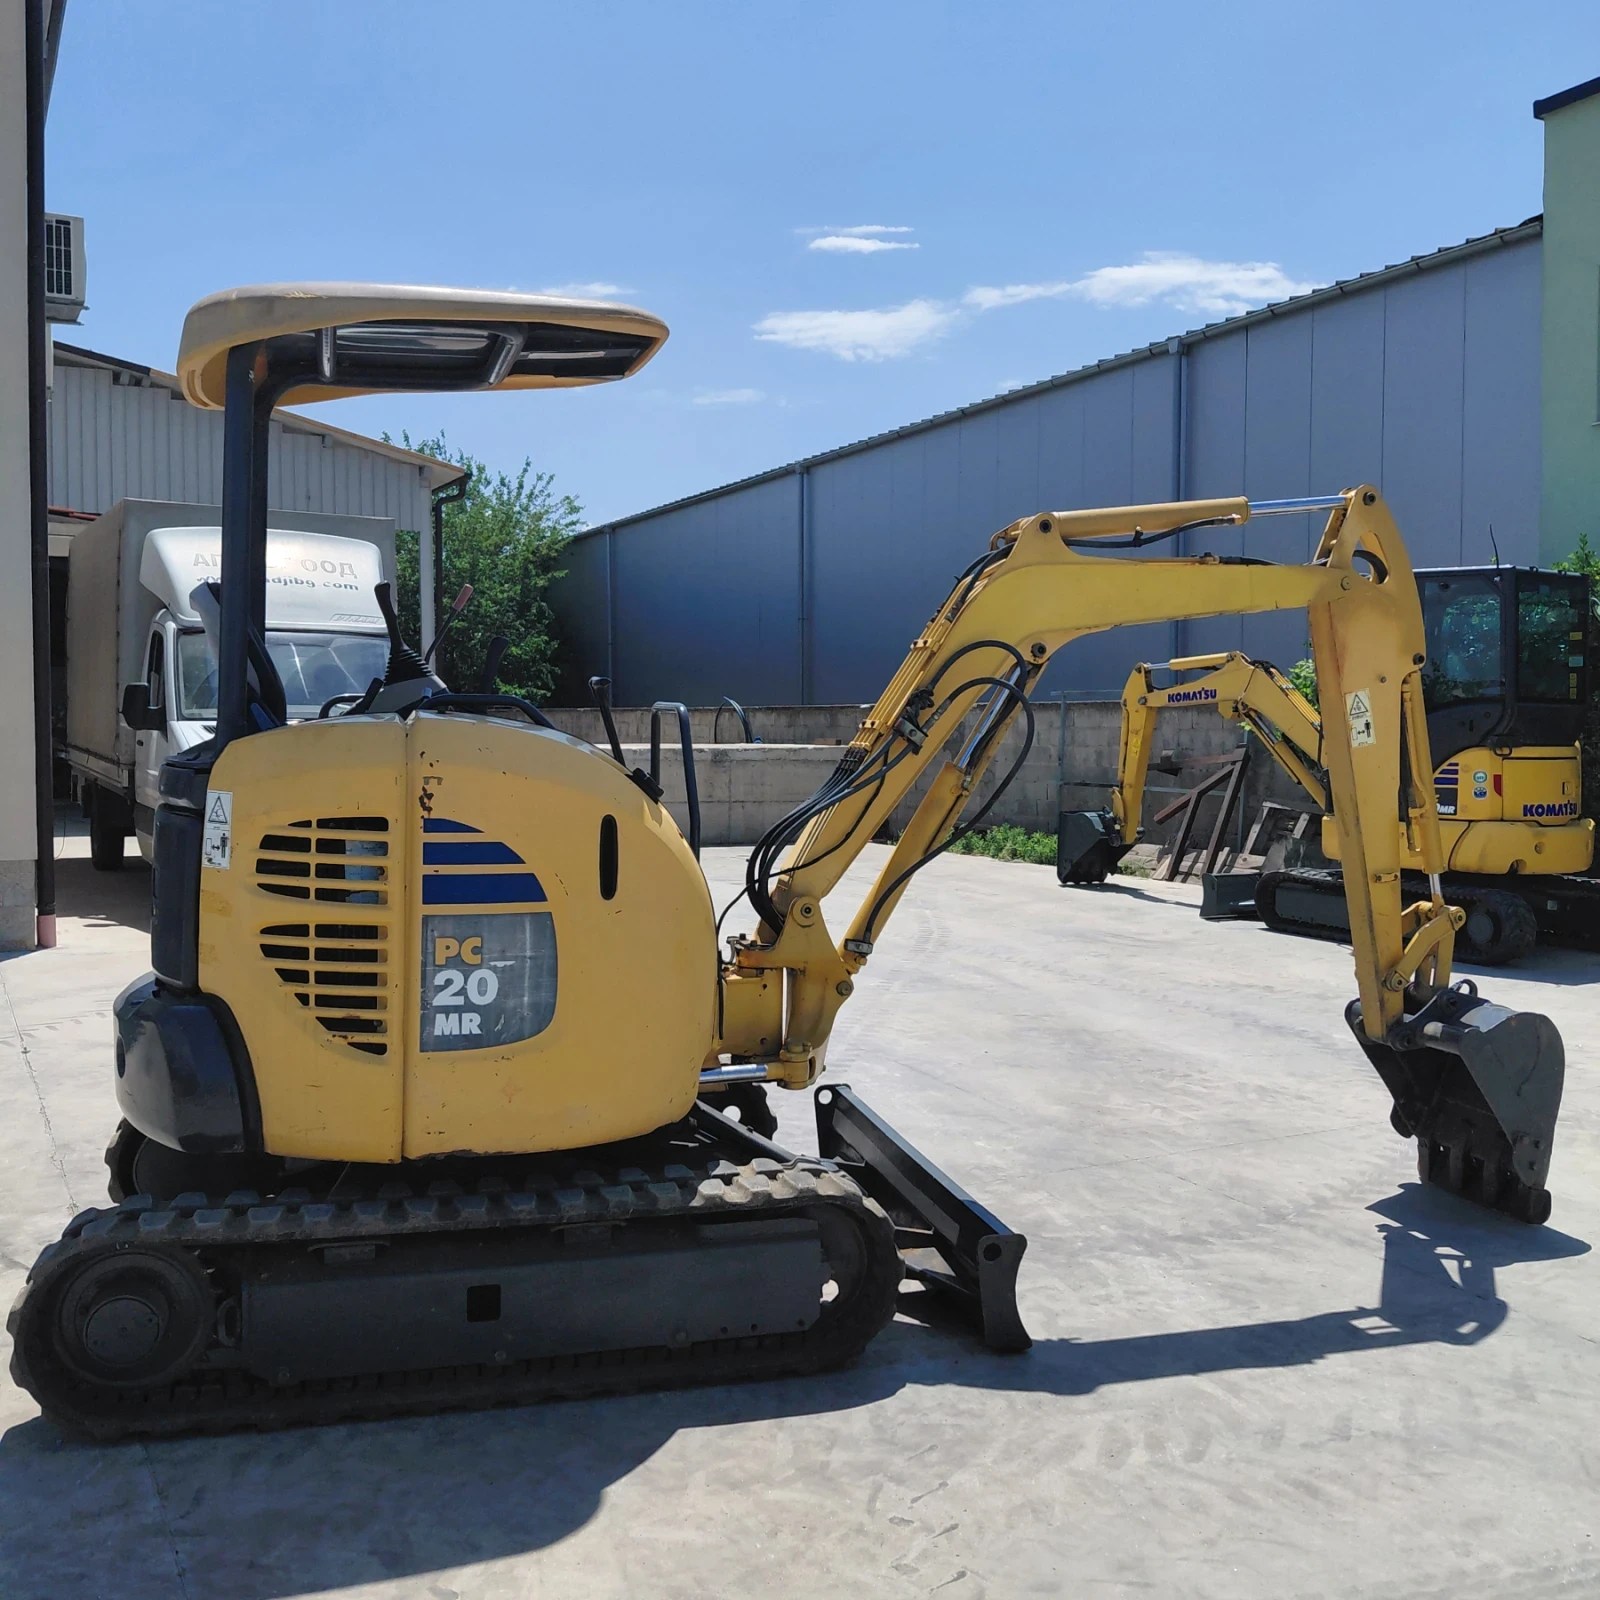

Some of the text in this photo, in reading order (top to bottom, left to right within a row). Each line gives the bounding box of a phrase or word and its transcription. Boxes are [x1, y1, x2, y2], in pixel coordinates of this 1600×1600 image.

[300, 559, 358, 579] ООД
[1167, 687, 1217, 703] KOMATSU
[1522, 799, 1578, 817] KOMATSU
[434, 936, 483, 966] PC
[432, 968, 499, 1006] 20
[433, 1012, 482, 1036] MR
